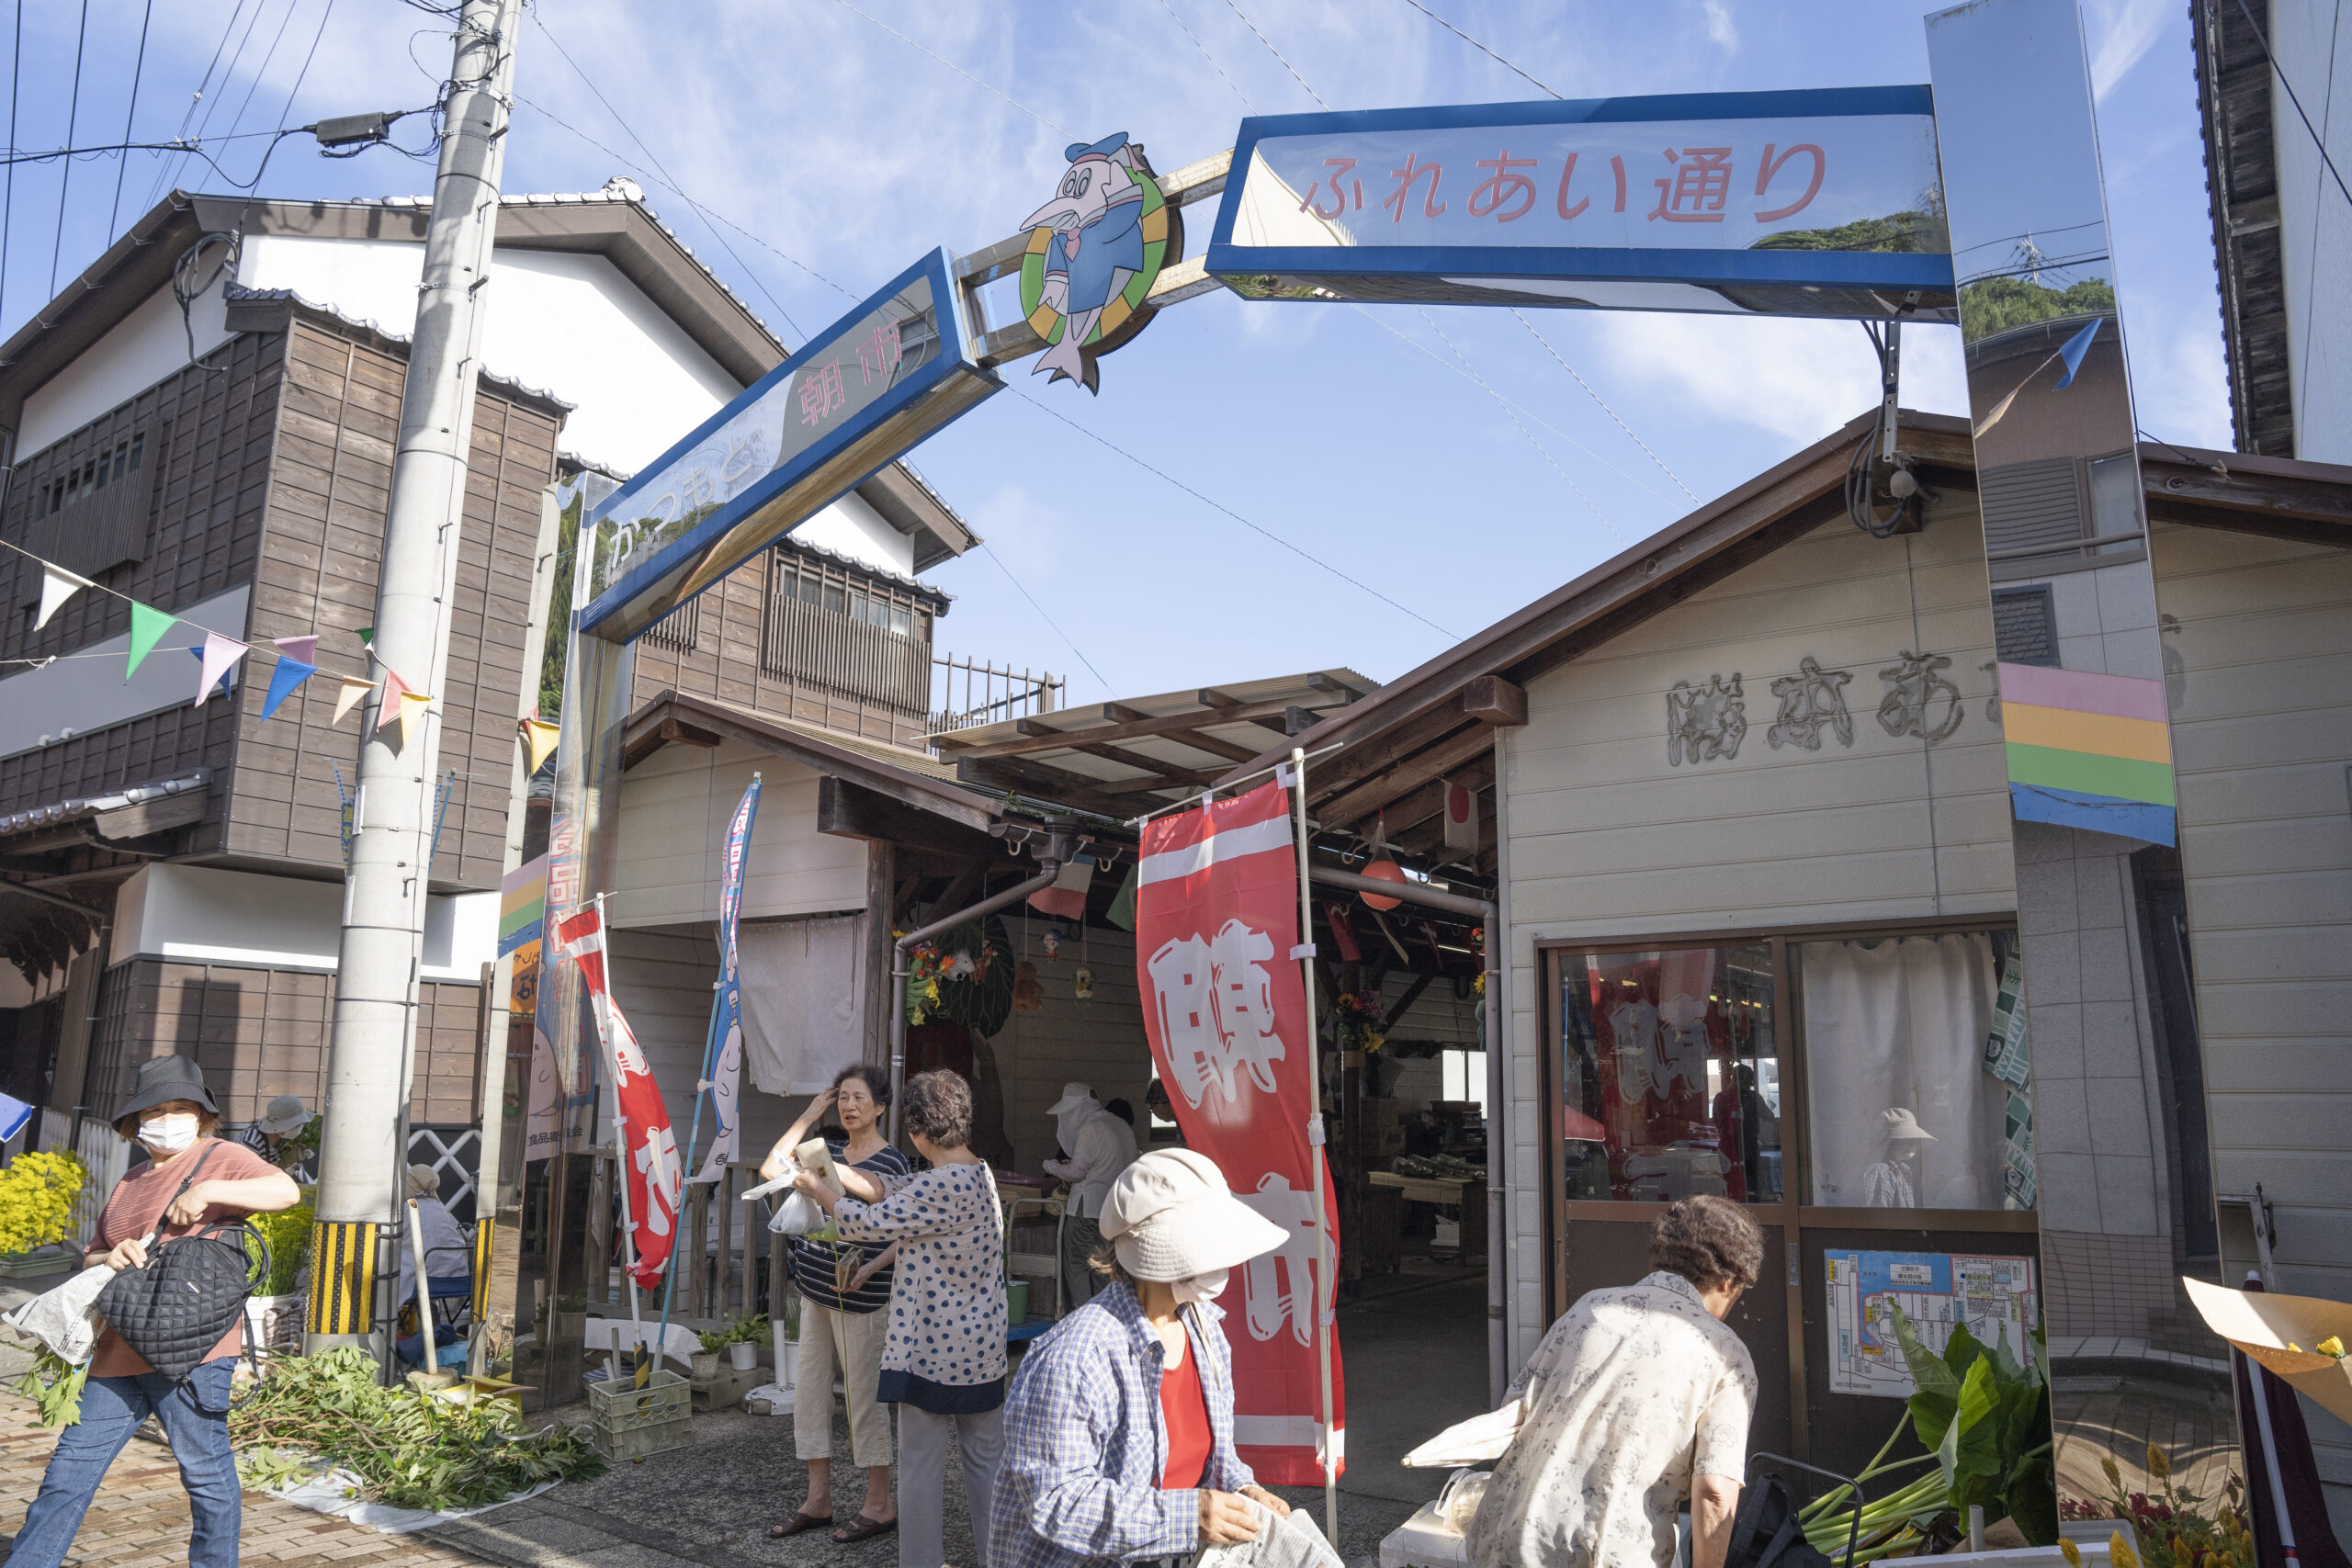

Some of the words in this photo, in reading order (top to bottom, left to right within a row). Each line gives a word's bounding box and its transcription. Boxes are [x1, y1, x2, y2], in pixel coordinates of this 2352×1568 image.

[1298, 143, 1826, 224] ふれあい通り
[608, 435, 752, 570] かつもと
[797, 318, 902, 427] 朝市
[1667, 650, 2000, 767] 勝本あ
